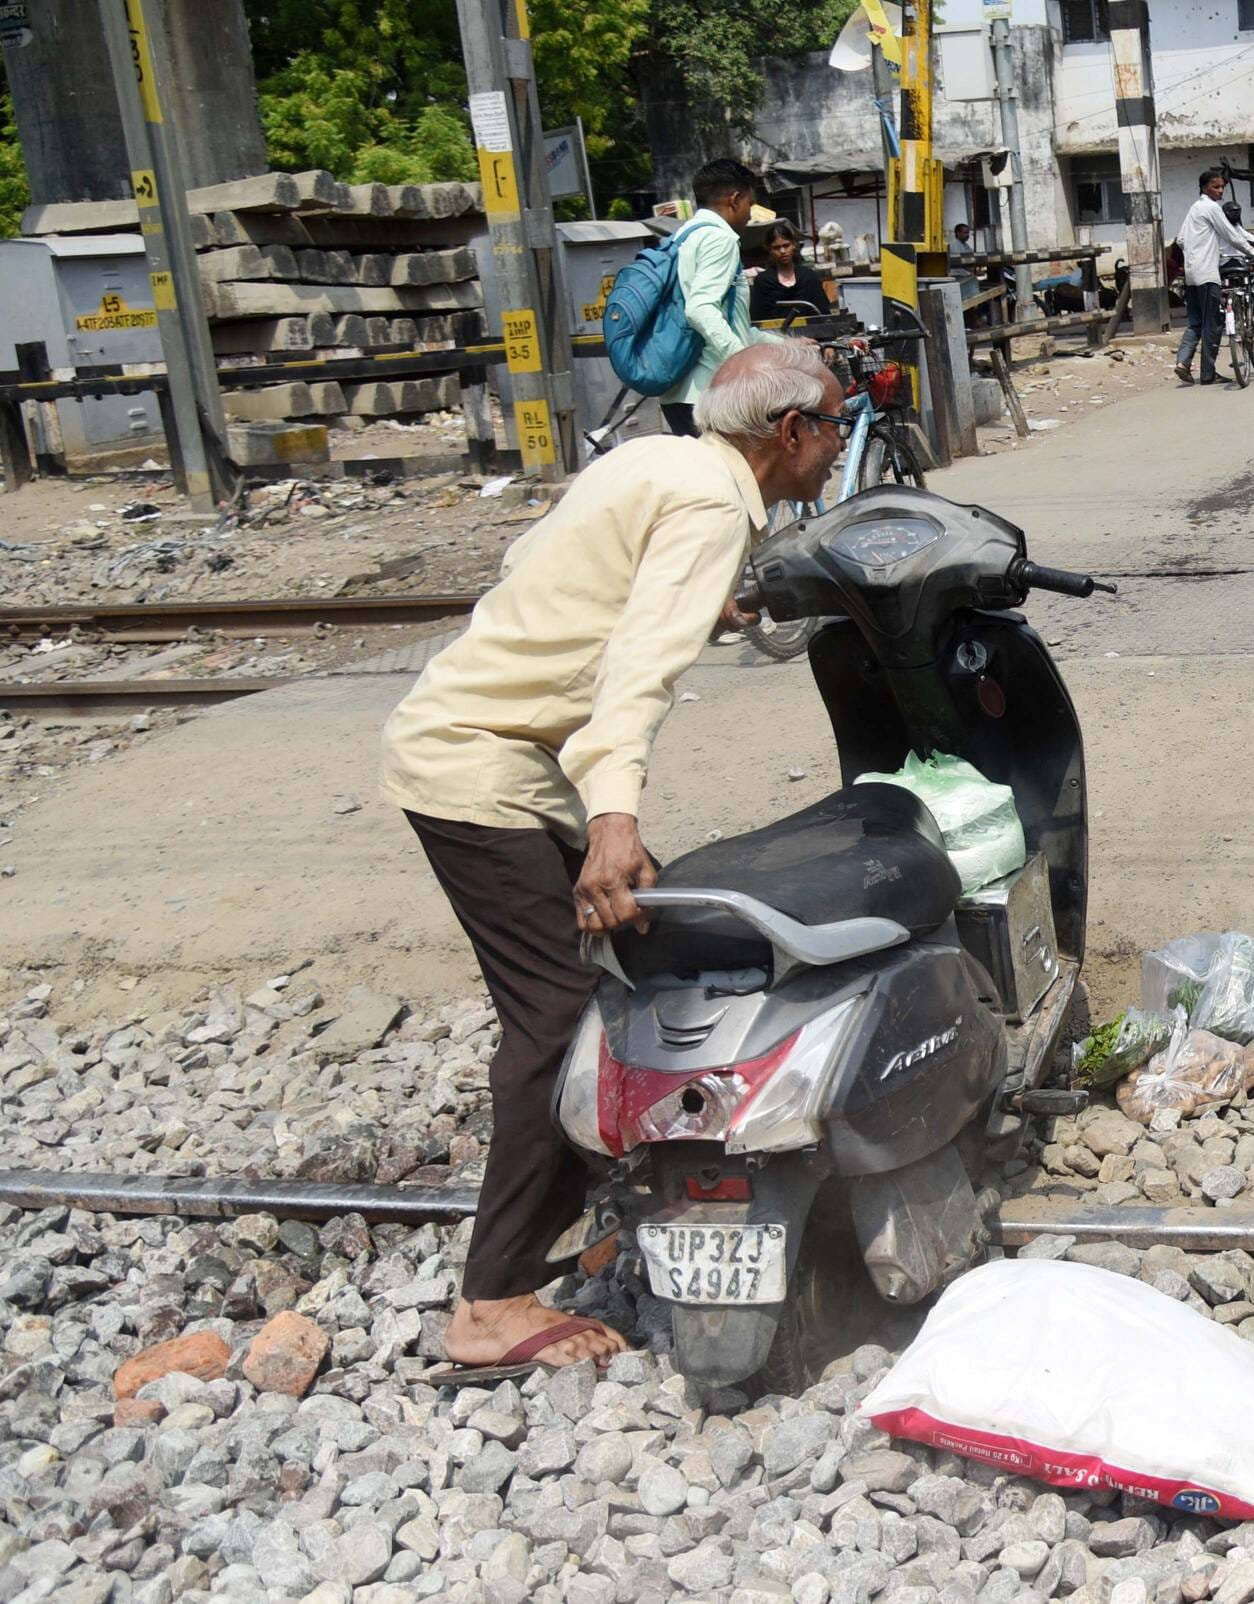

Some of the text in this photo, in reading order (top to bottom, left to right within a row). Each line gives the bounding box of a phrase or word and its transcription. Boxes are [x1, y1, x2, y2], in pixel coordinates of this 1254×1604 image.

[527, 435, 548, 449] 50
[668, 1229, 764, 1264] UP32J
[668, 1266, 761, 1300] S4947
